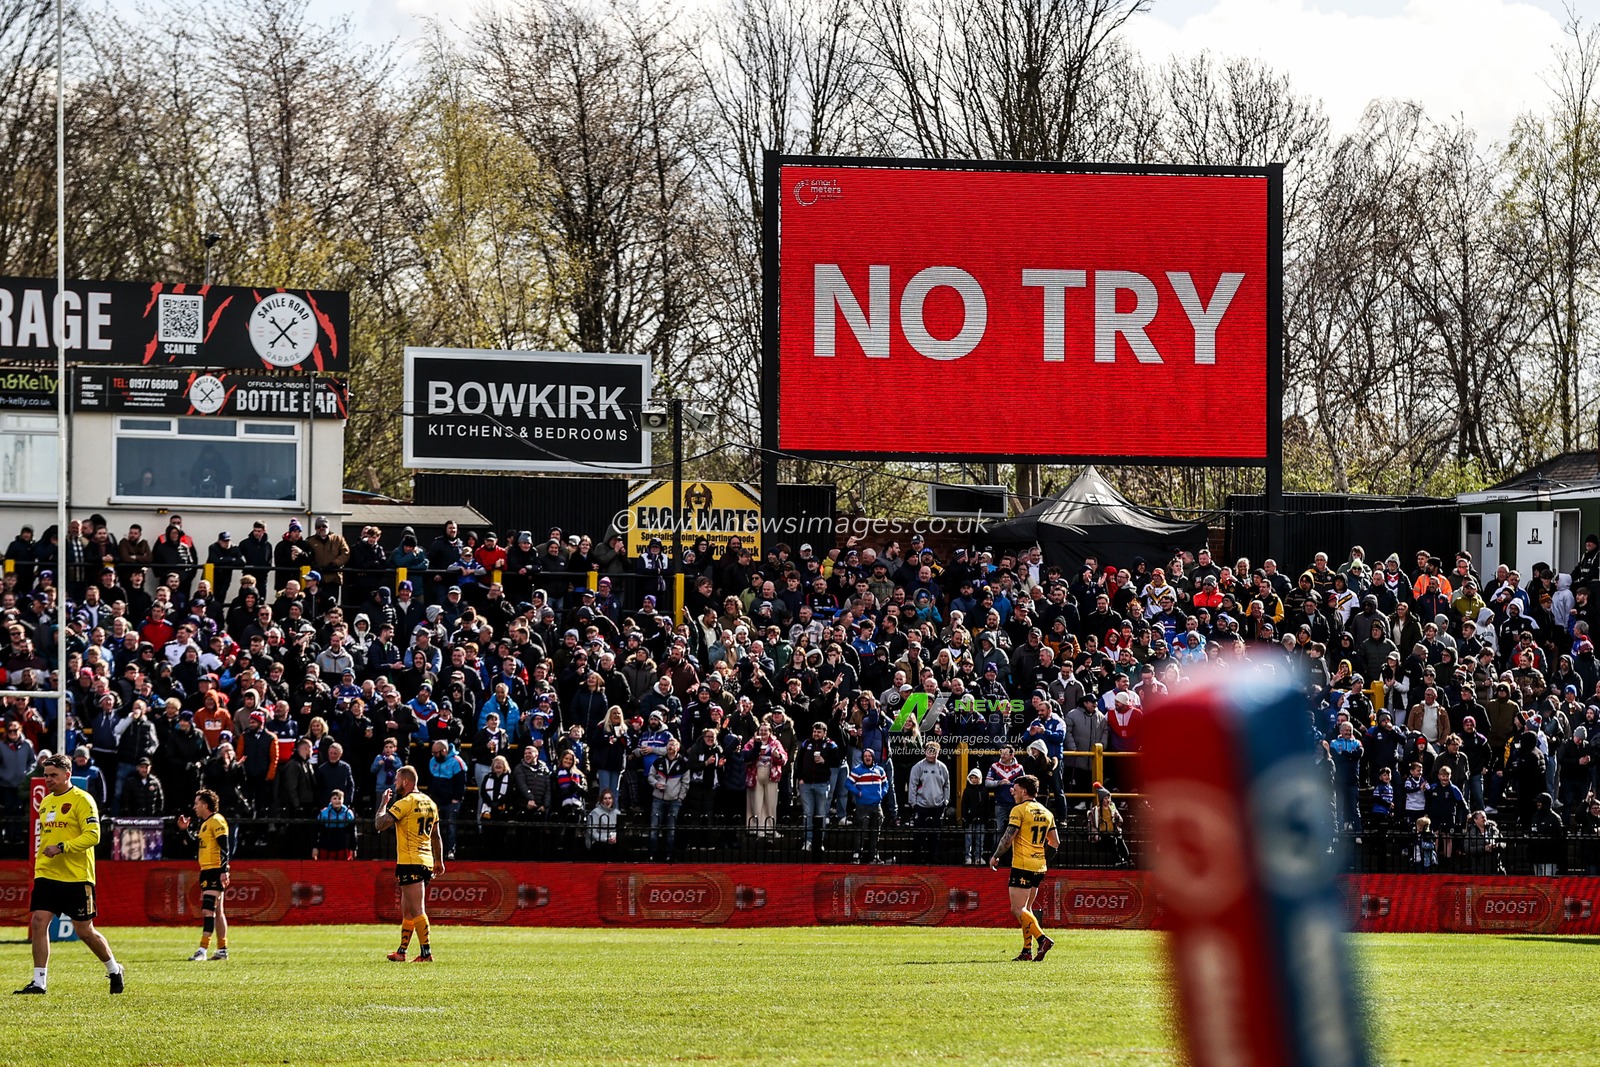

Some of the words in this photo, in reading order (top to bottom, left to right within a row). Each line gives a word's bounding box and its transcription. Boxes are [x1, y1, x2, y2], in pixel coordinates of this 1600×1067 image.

[257, 297, 285, 319] SAVILE
[288, 299, 310, 320] ROAD
[813, 263, 988, 361] NO
[1021, 268, 1246, 365] TRY
[164, 343, 184, 354] SCAN
[185, 344, 197, 354] ME
[266, 351, 301, 362] GARAGE
[113, 378, 128, 388] TEL:
[129, 378, 150, 389] 01977
[151, 379, 179, 389] 668100
[236, 389, 299, 412] BOTTLE
[303, 392, 338, 413] BAR
[428, 380, 627, 420] BOWKIRK
[428, 424, 514, 438] KITCHENS
[519, 427, 529, 438] &
[534, 427, 628, 441] BEDROOMS
[637, 506, 693, 530] EAGE
[696, 508, 759, 532] DARTS
[641, 532, 675, 541] Specialis
[679, 532, 697, 541] oints
[417, 817, 434, 835] 16
[1031, 825, 1047, 844] 11
[224, 886, 260, 901] OST
[429, 887, 488, 901] BOOST
[649, 889, 706, 903] BOOST
[864, 890, 920, 904] BOOST
[1074, 894, 1128, 908] BOOST
[1485, 900, 1537, 914] BOOST
